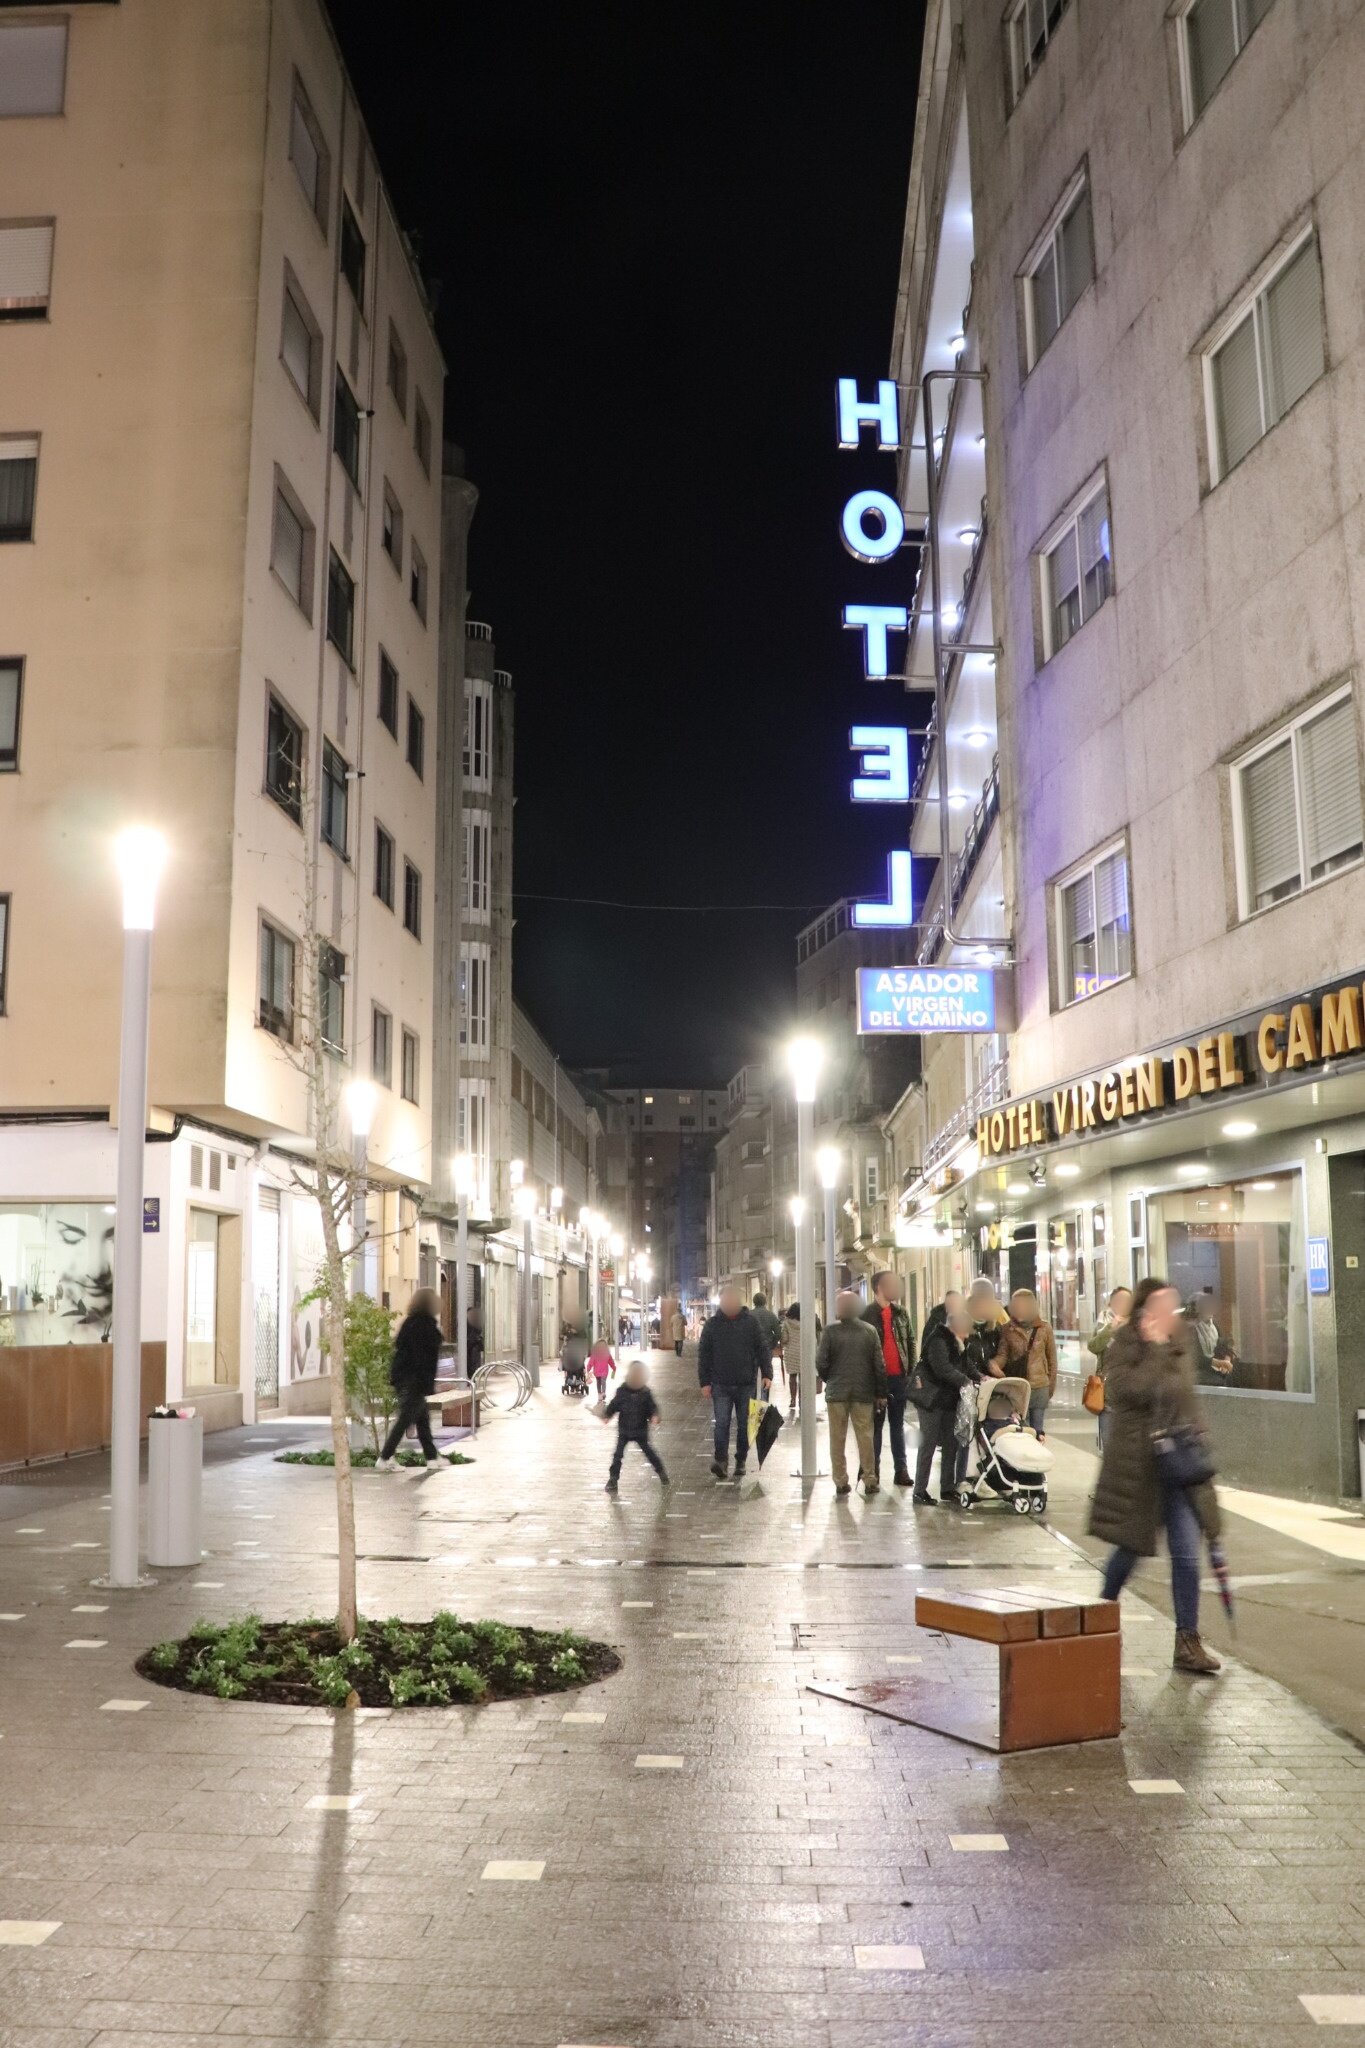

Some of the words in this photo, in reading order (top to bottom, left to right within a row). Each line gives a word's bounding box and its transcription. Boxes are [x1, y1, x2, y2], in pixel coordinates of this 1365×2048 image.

[876, 973, 980, 993] ASADOR
[891, 996, 965, 1012] VIRGEN
[869, 1011, 903, 1026] DEL
[907, 1010, 988, 1027] CAMINO
[977, 1099, 1046, 1158] HOTEL
[1053, 1057, 1164, 1137] VIRGEN
[1173, 1031, 1243, 1101] DEL
[1257, 979, 1365, 1074] CAM
[1309, 1243, 1326, 1269] HR
